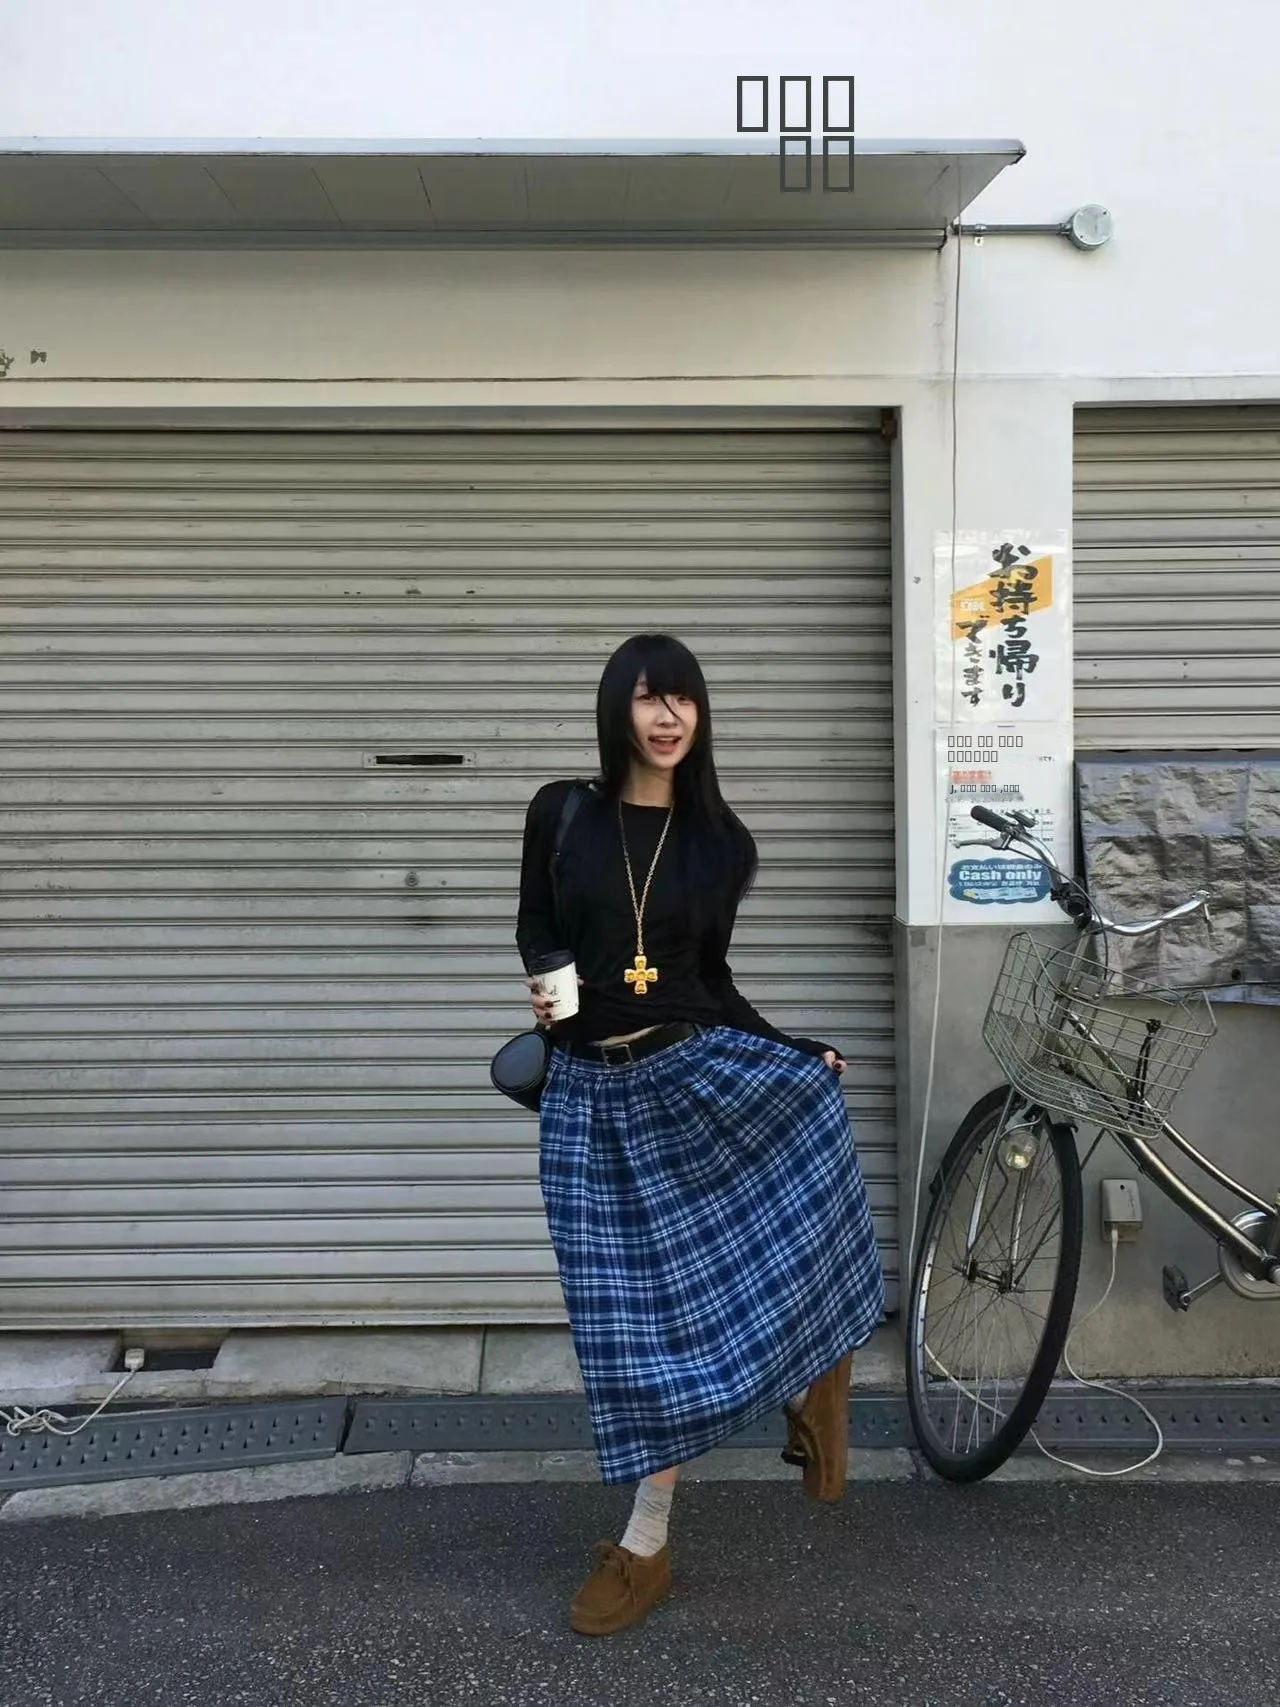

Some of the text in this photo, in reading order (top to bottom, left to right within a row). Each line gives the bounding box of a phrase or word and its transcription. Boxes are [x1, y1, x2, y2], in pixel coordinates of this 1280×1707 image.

[955, 614, 990, 708] できます
[987, 542, 1040, 708] お持ち帰り
[959, 870, 1042, 881] Cash only
